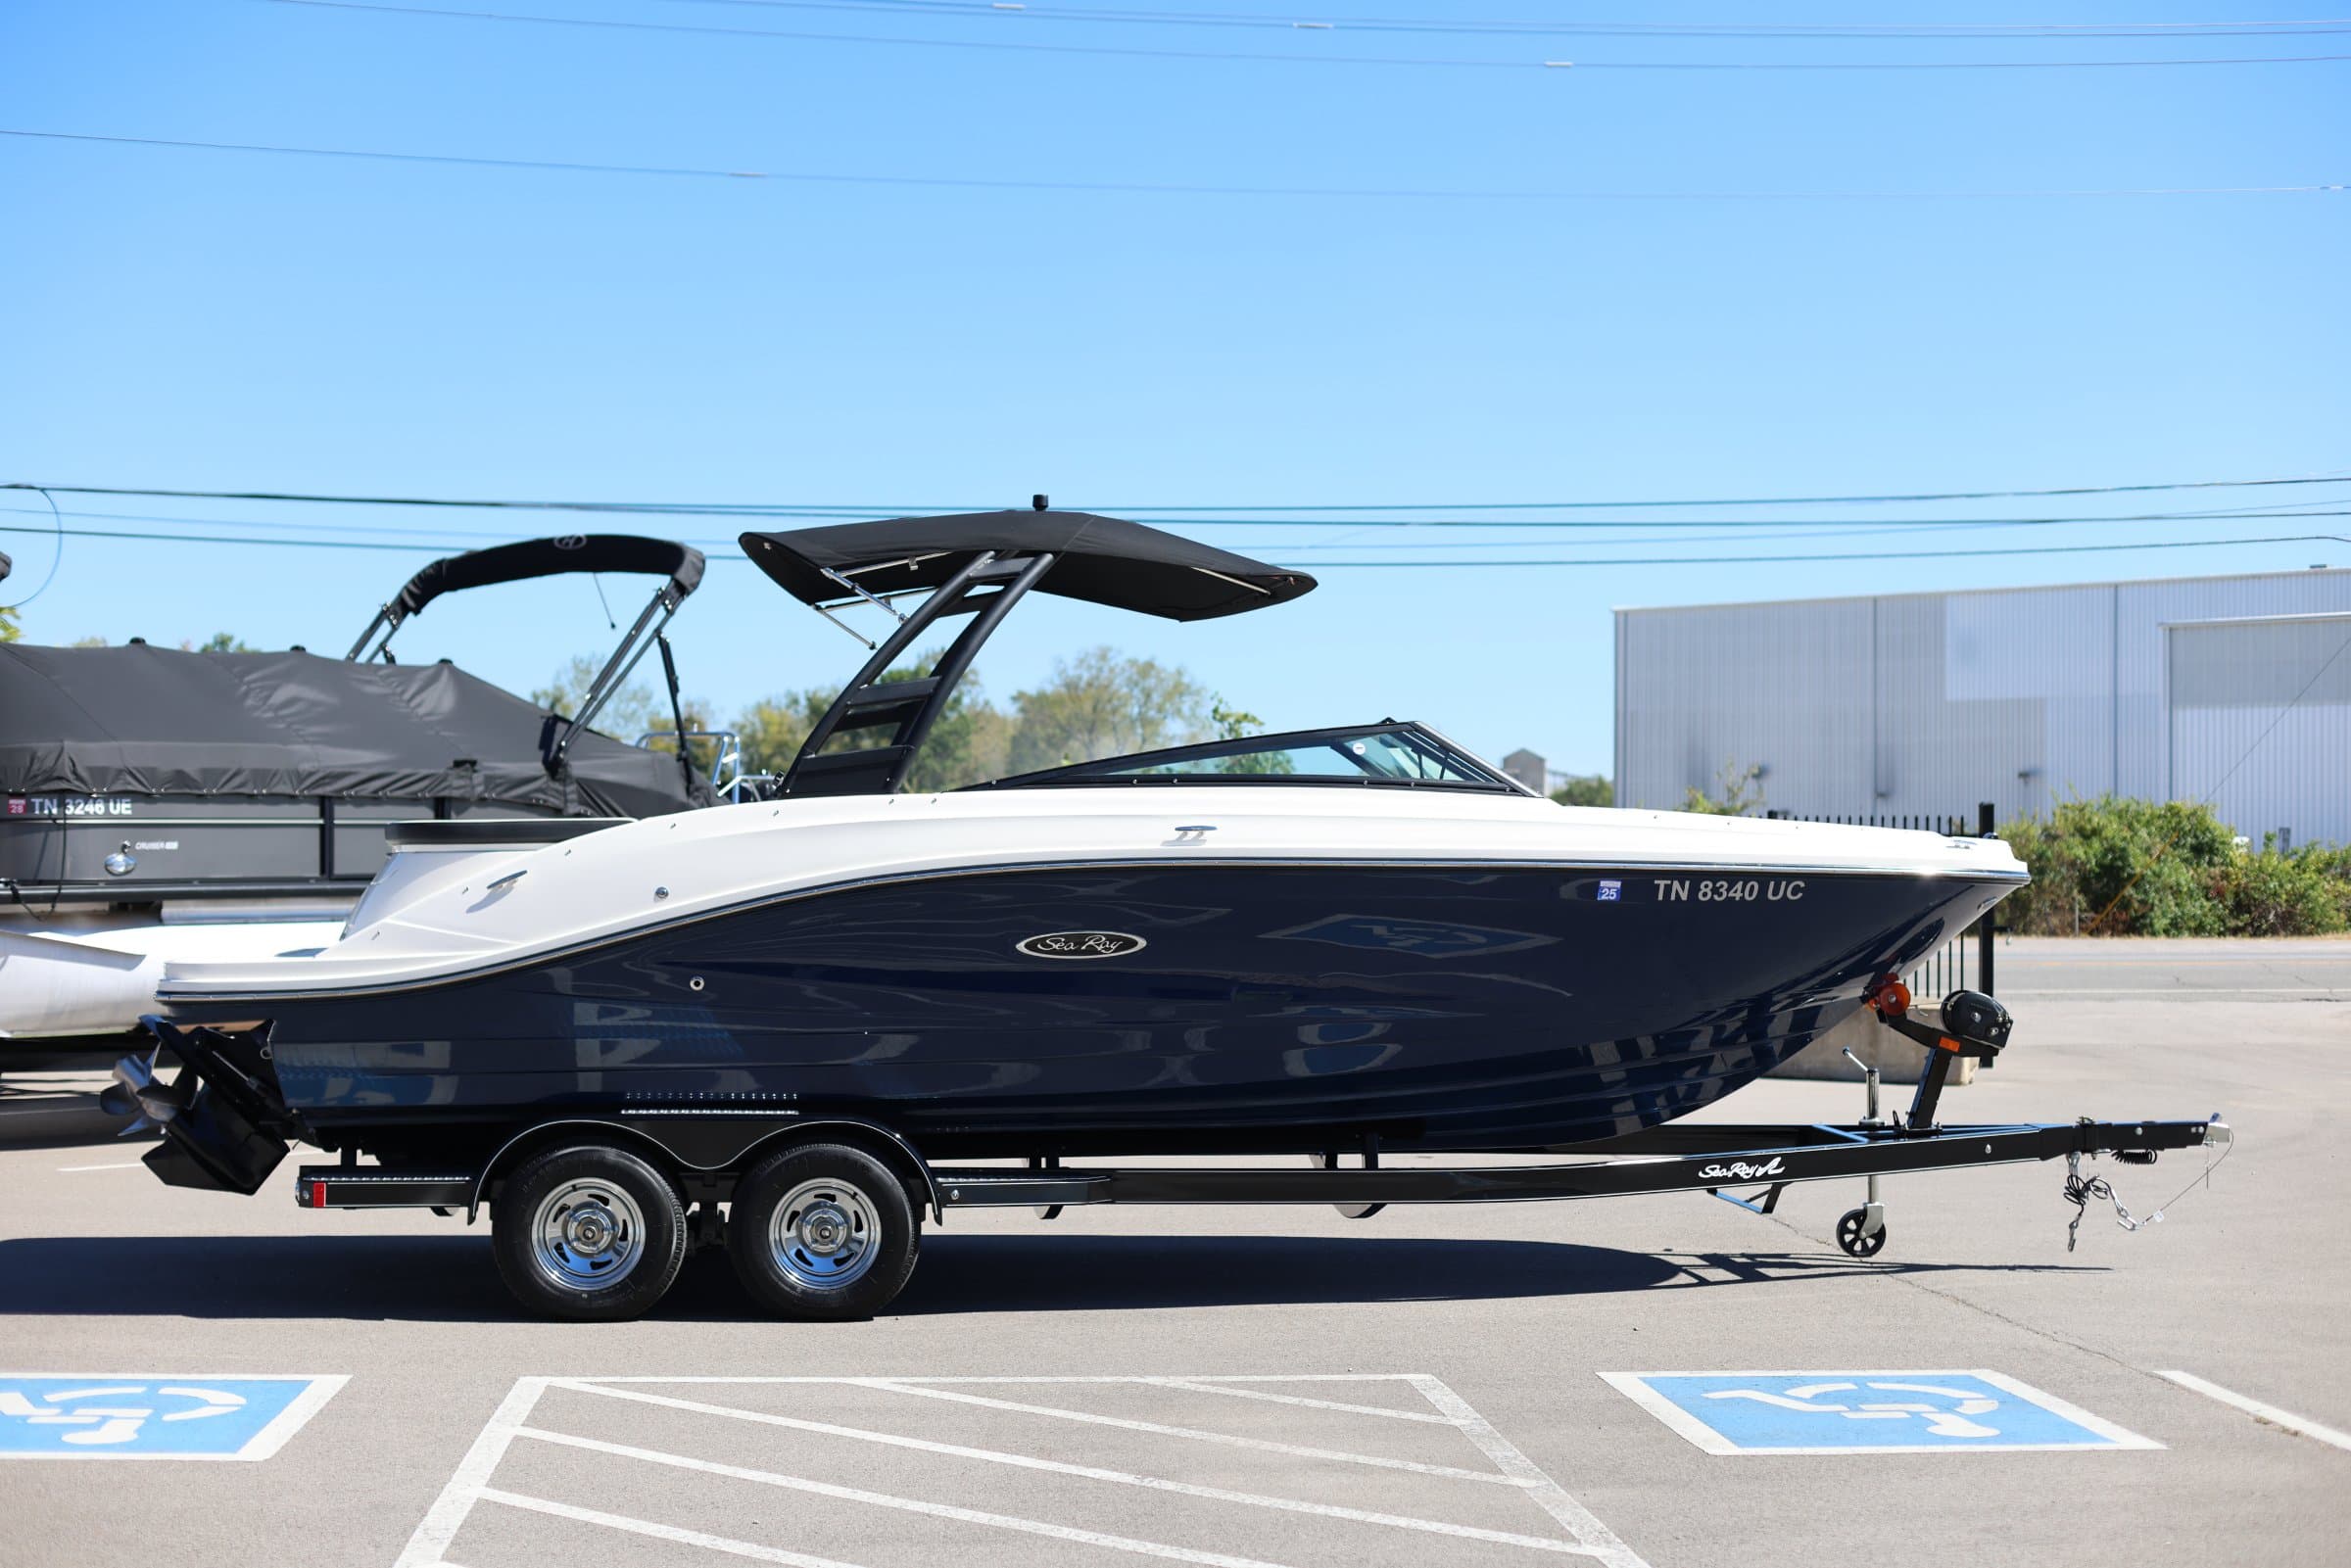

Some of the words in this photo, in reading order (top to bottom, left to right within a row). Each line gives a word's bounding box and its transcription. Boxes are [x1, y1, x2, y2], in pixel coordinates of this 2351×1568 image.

[31, 798, 58, 815] TN
[109, 798, 132, 815] UE
[1601, 887, 1618, 900] 25
[1654, 879, 1690, 901] TN
[1698, 880, 1759, 902] 8340
[1766, 880, 1805, 901] UC
[1036, 936, 1078, 951] Sea
[1080, 934, 1124, 954] Ray
[1698, 1164, 1728, 1178] Sea
[1727, 1162, 1759, 1179] Ray
